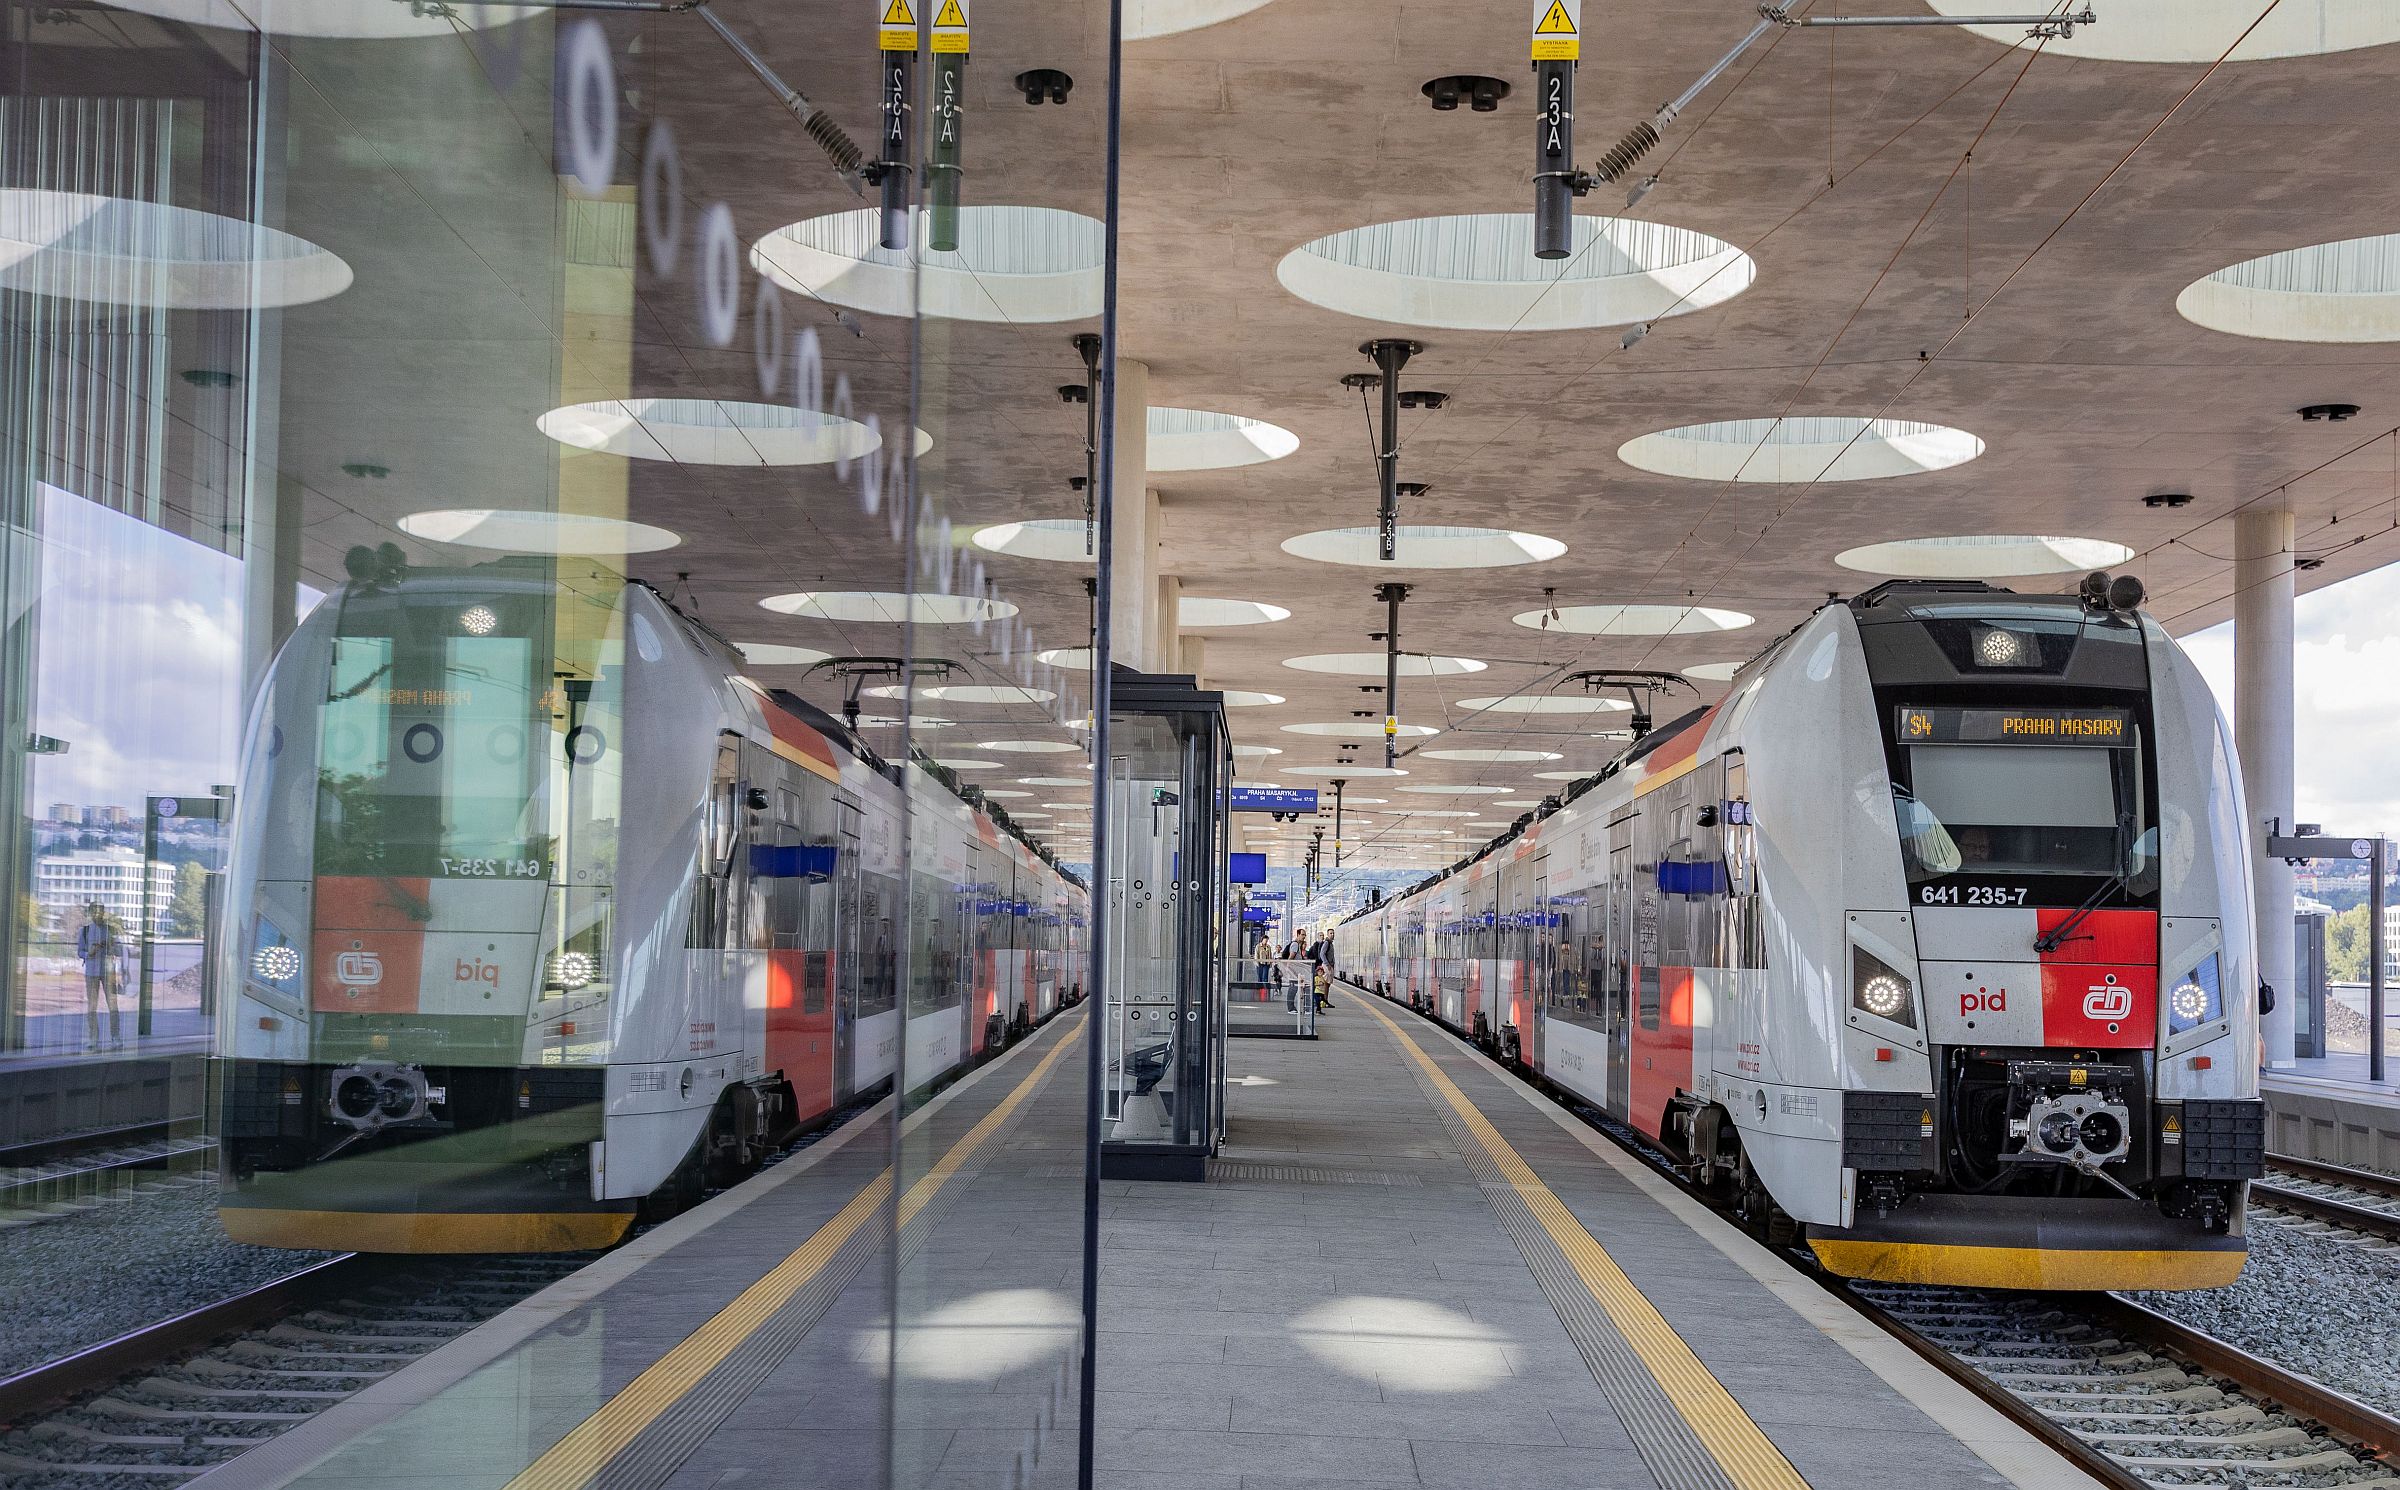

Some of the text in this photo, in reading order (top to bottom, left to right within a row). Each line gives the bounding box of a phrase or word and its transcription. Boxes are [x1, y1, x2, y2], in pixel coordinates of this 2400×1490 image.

[1546, 77, 1562, 150] 23A
[1910, 714, 1933, 736] S4
[2003, 717, 2123, 736] PRAHA MASARY
[1921, 886, 2028, 906] 641 235-7
[1960, 986, 2006, 1017] pid
